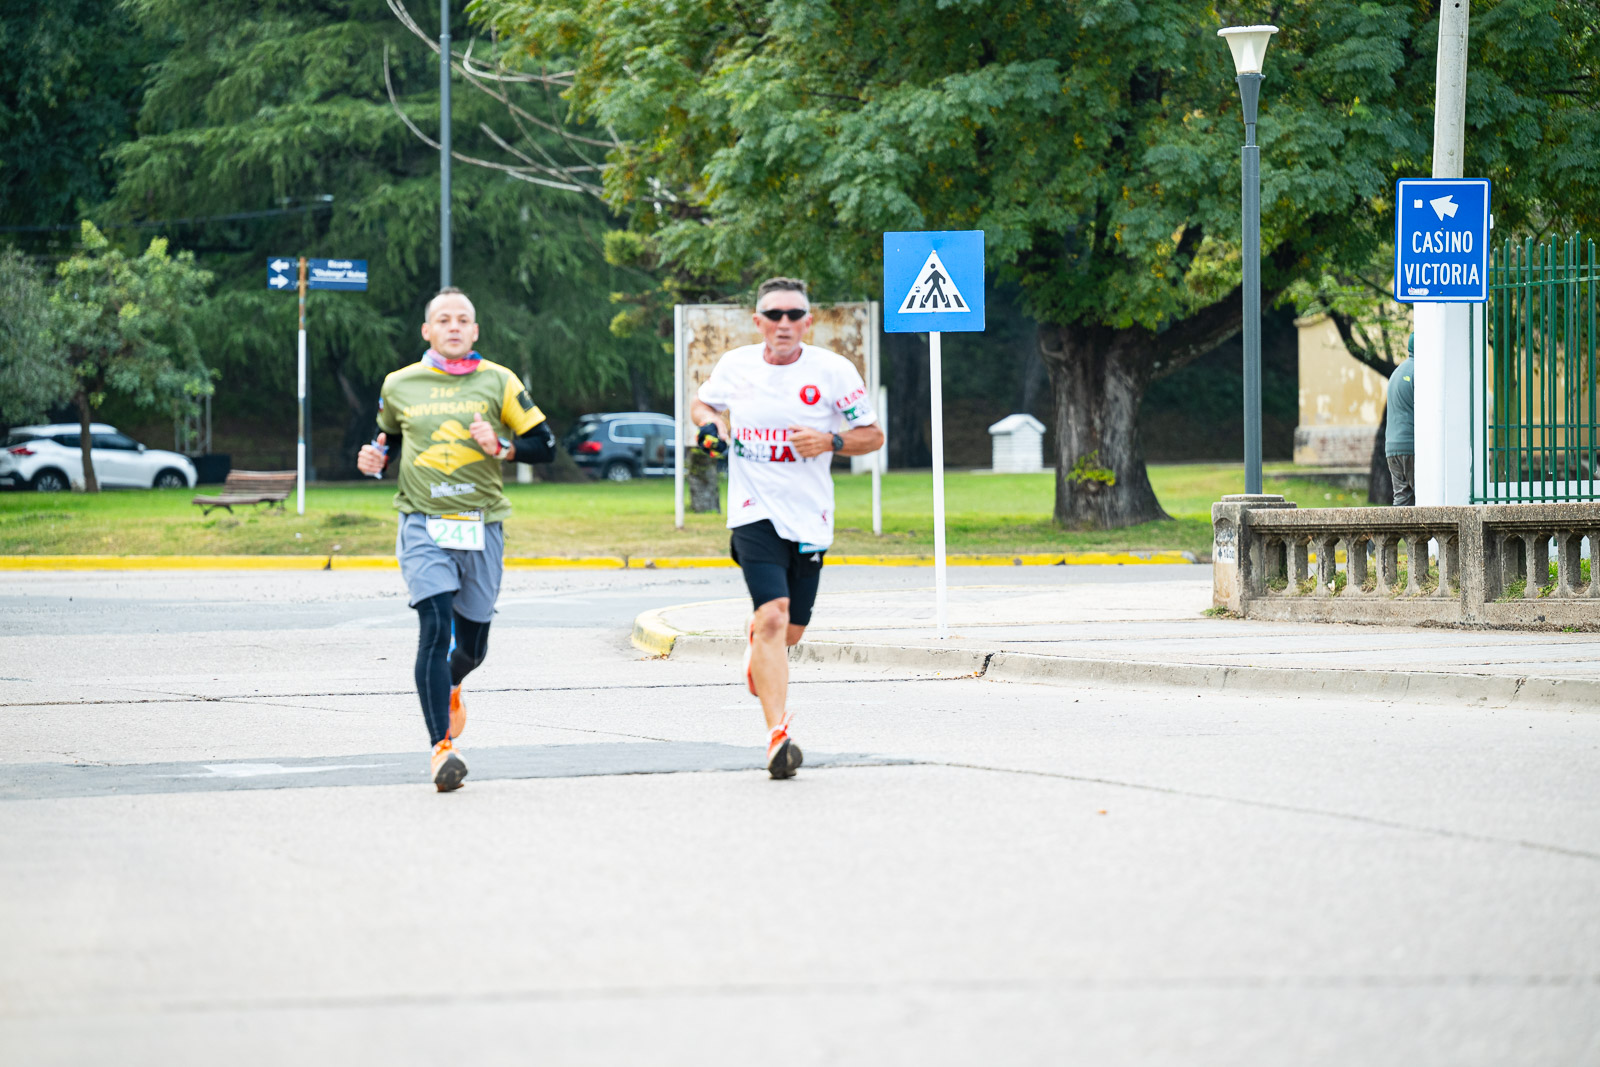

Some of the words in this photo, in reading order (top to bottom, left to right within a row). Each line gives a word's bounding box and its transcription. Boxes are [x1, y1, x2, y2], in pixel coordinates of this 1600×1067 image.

[1412, 231, 1473, 253] CASINO
[1404, 263, 1480, 286] VICTORIA
[434, 522, 478, 545] 241
